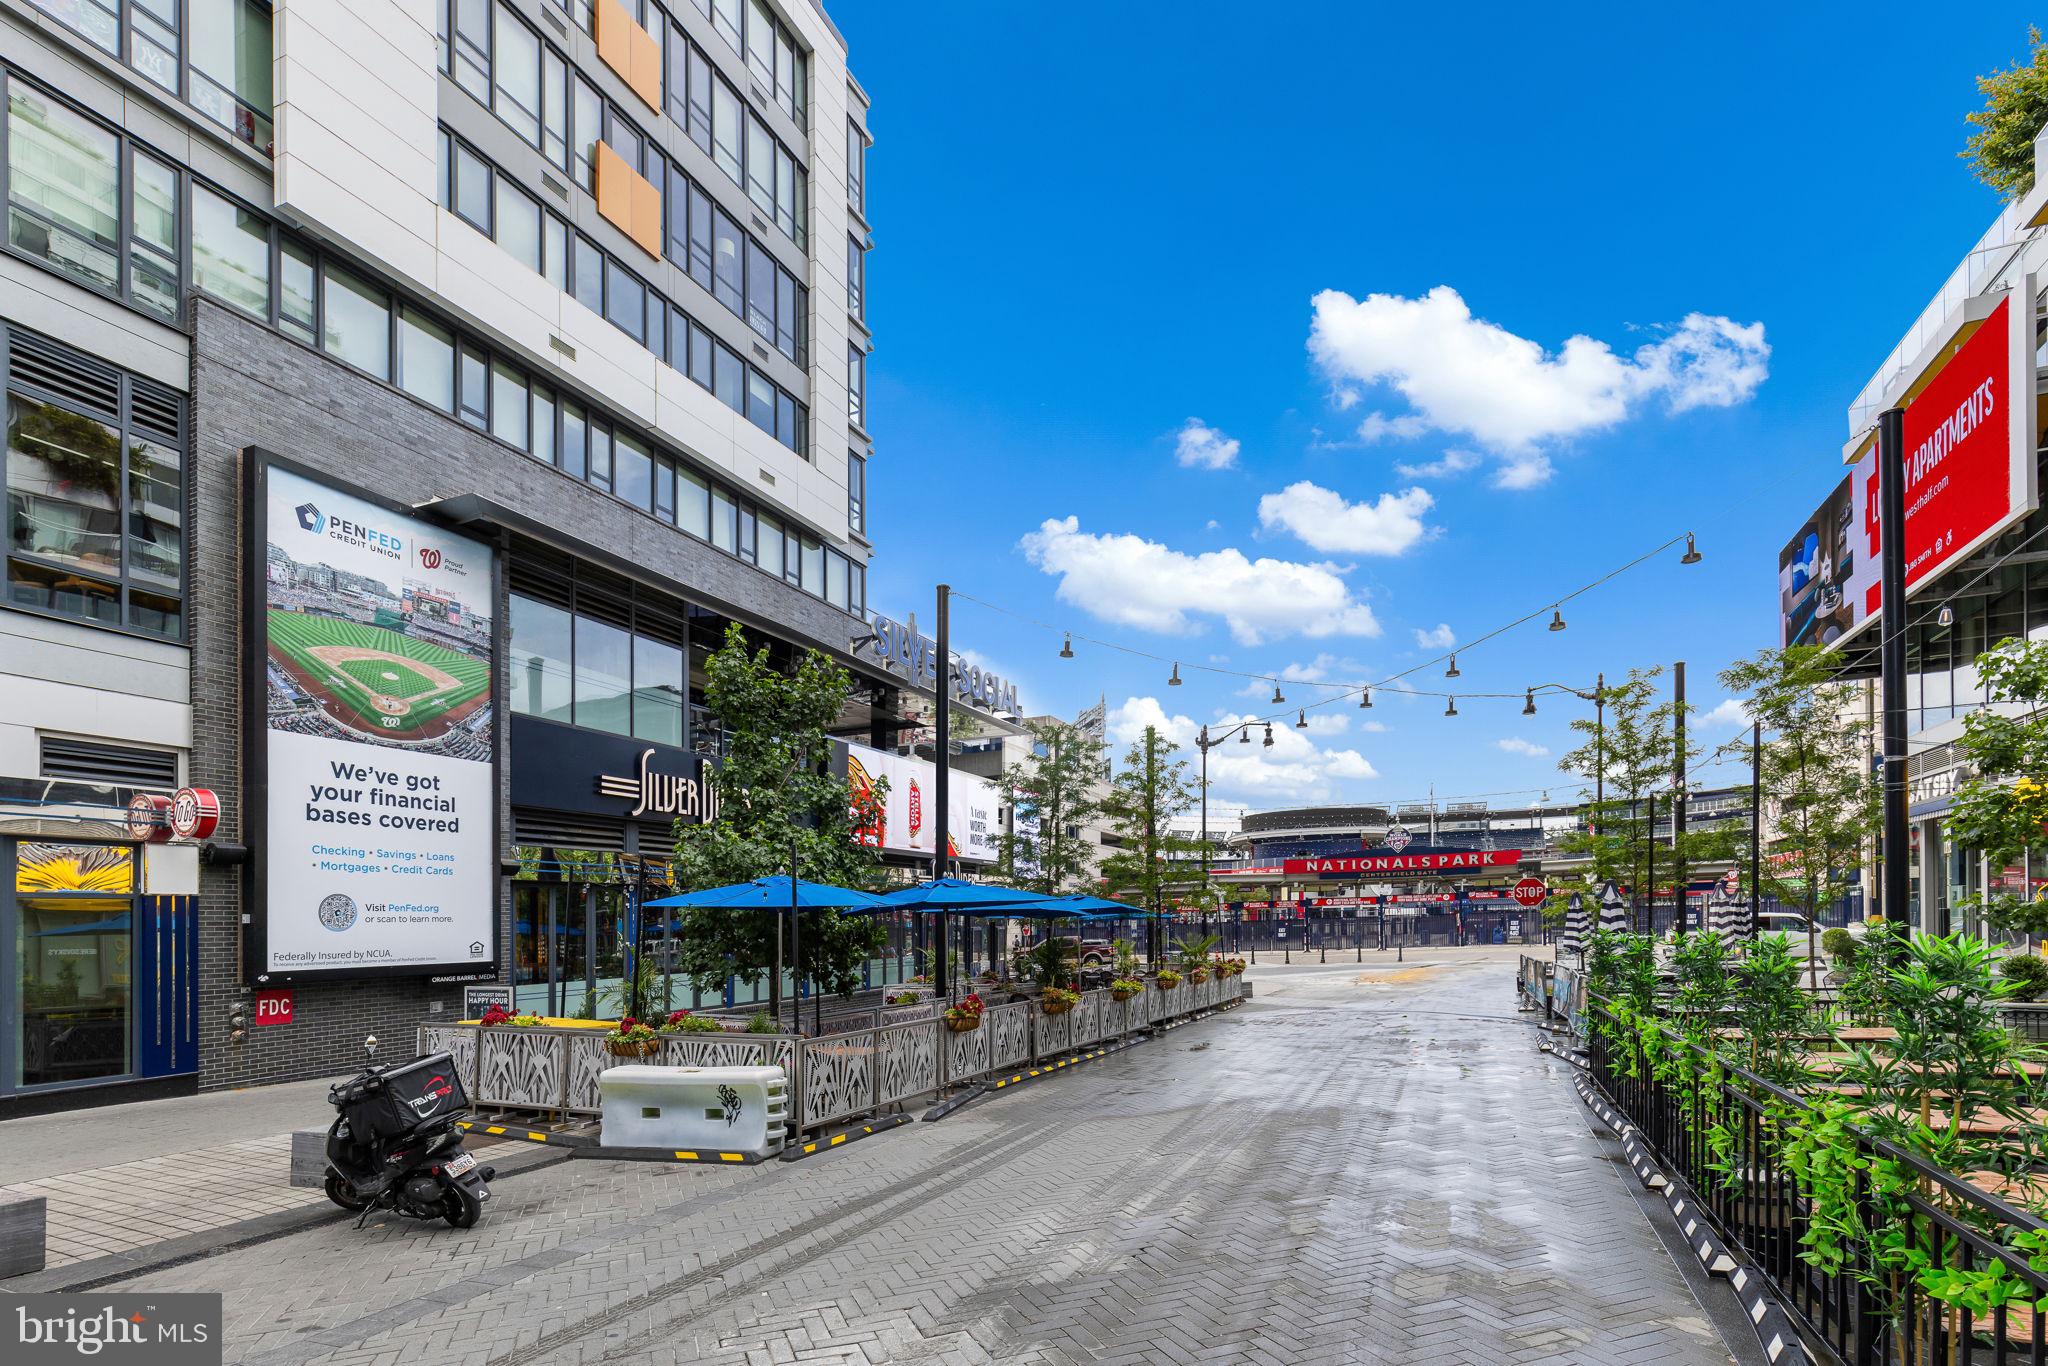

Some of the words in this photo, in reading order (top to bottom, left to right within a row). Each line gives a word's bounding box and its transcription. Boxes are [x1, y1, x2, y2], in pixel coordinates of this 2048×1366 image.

[1912, 375, 1994, 488] APARTMENTS
[1904, 474, 1949, 521] westhalf.com
[330, 515, 402, 552] PENFED
[330, 531, 367, 549] CREDIT
[370, 544, 402, 561] UNION
[444, 557, 464, 570] Proud
[1917, 547, 1932, 565] SMITH
[444, 564, 468, 577] Partner
[871, 612, 937, 688] SILVE
[957, 657, 1022, 718] SOCIAL
[406, 774, 440, 792] got
[310, 784, 363, 803] your
[370, 788, 456, 813] financial
[306, 803, 372, 826] bases
[379, 814, 460, 833] covered
[970, 820, 987, 834] WORTH
[970, 833, 983, 847] MORE
[312, 844, 366, 859] Checking
[376, 849, 417, 861] Savings
[426, 852, 455, 862] Loans
[1306, 856, 1431, 871] NATIONALS
[1439, 853, 1495, 867] PARK
[320, 861, 380, 874] Mortgages
[391, 864, 423, 875] Credit
[425, 866, 454, 876] Cards
[1516, 886, 1544, 898] STOP
[365, 903, 386, 912] Visit
[388, 903, 439, 914] PenFed.org
[376, 915, 396, 923] scan
[398, 915, 408, 923] to
[409, 915, 430, 923] learn
[273, 951, 317, 962] Federally
[318, 950, 352, 960] Insured
[353, 950, 364, 960] by
[366, 949, 393, 959] NCUA.
[432, 975, 456, 983] ORANGE
[258, 998, 291, 1017] FDC
[490, 997, 509, 1005] HOUR
